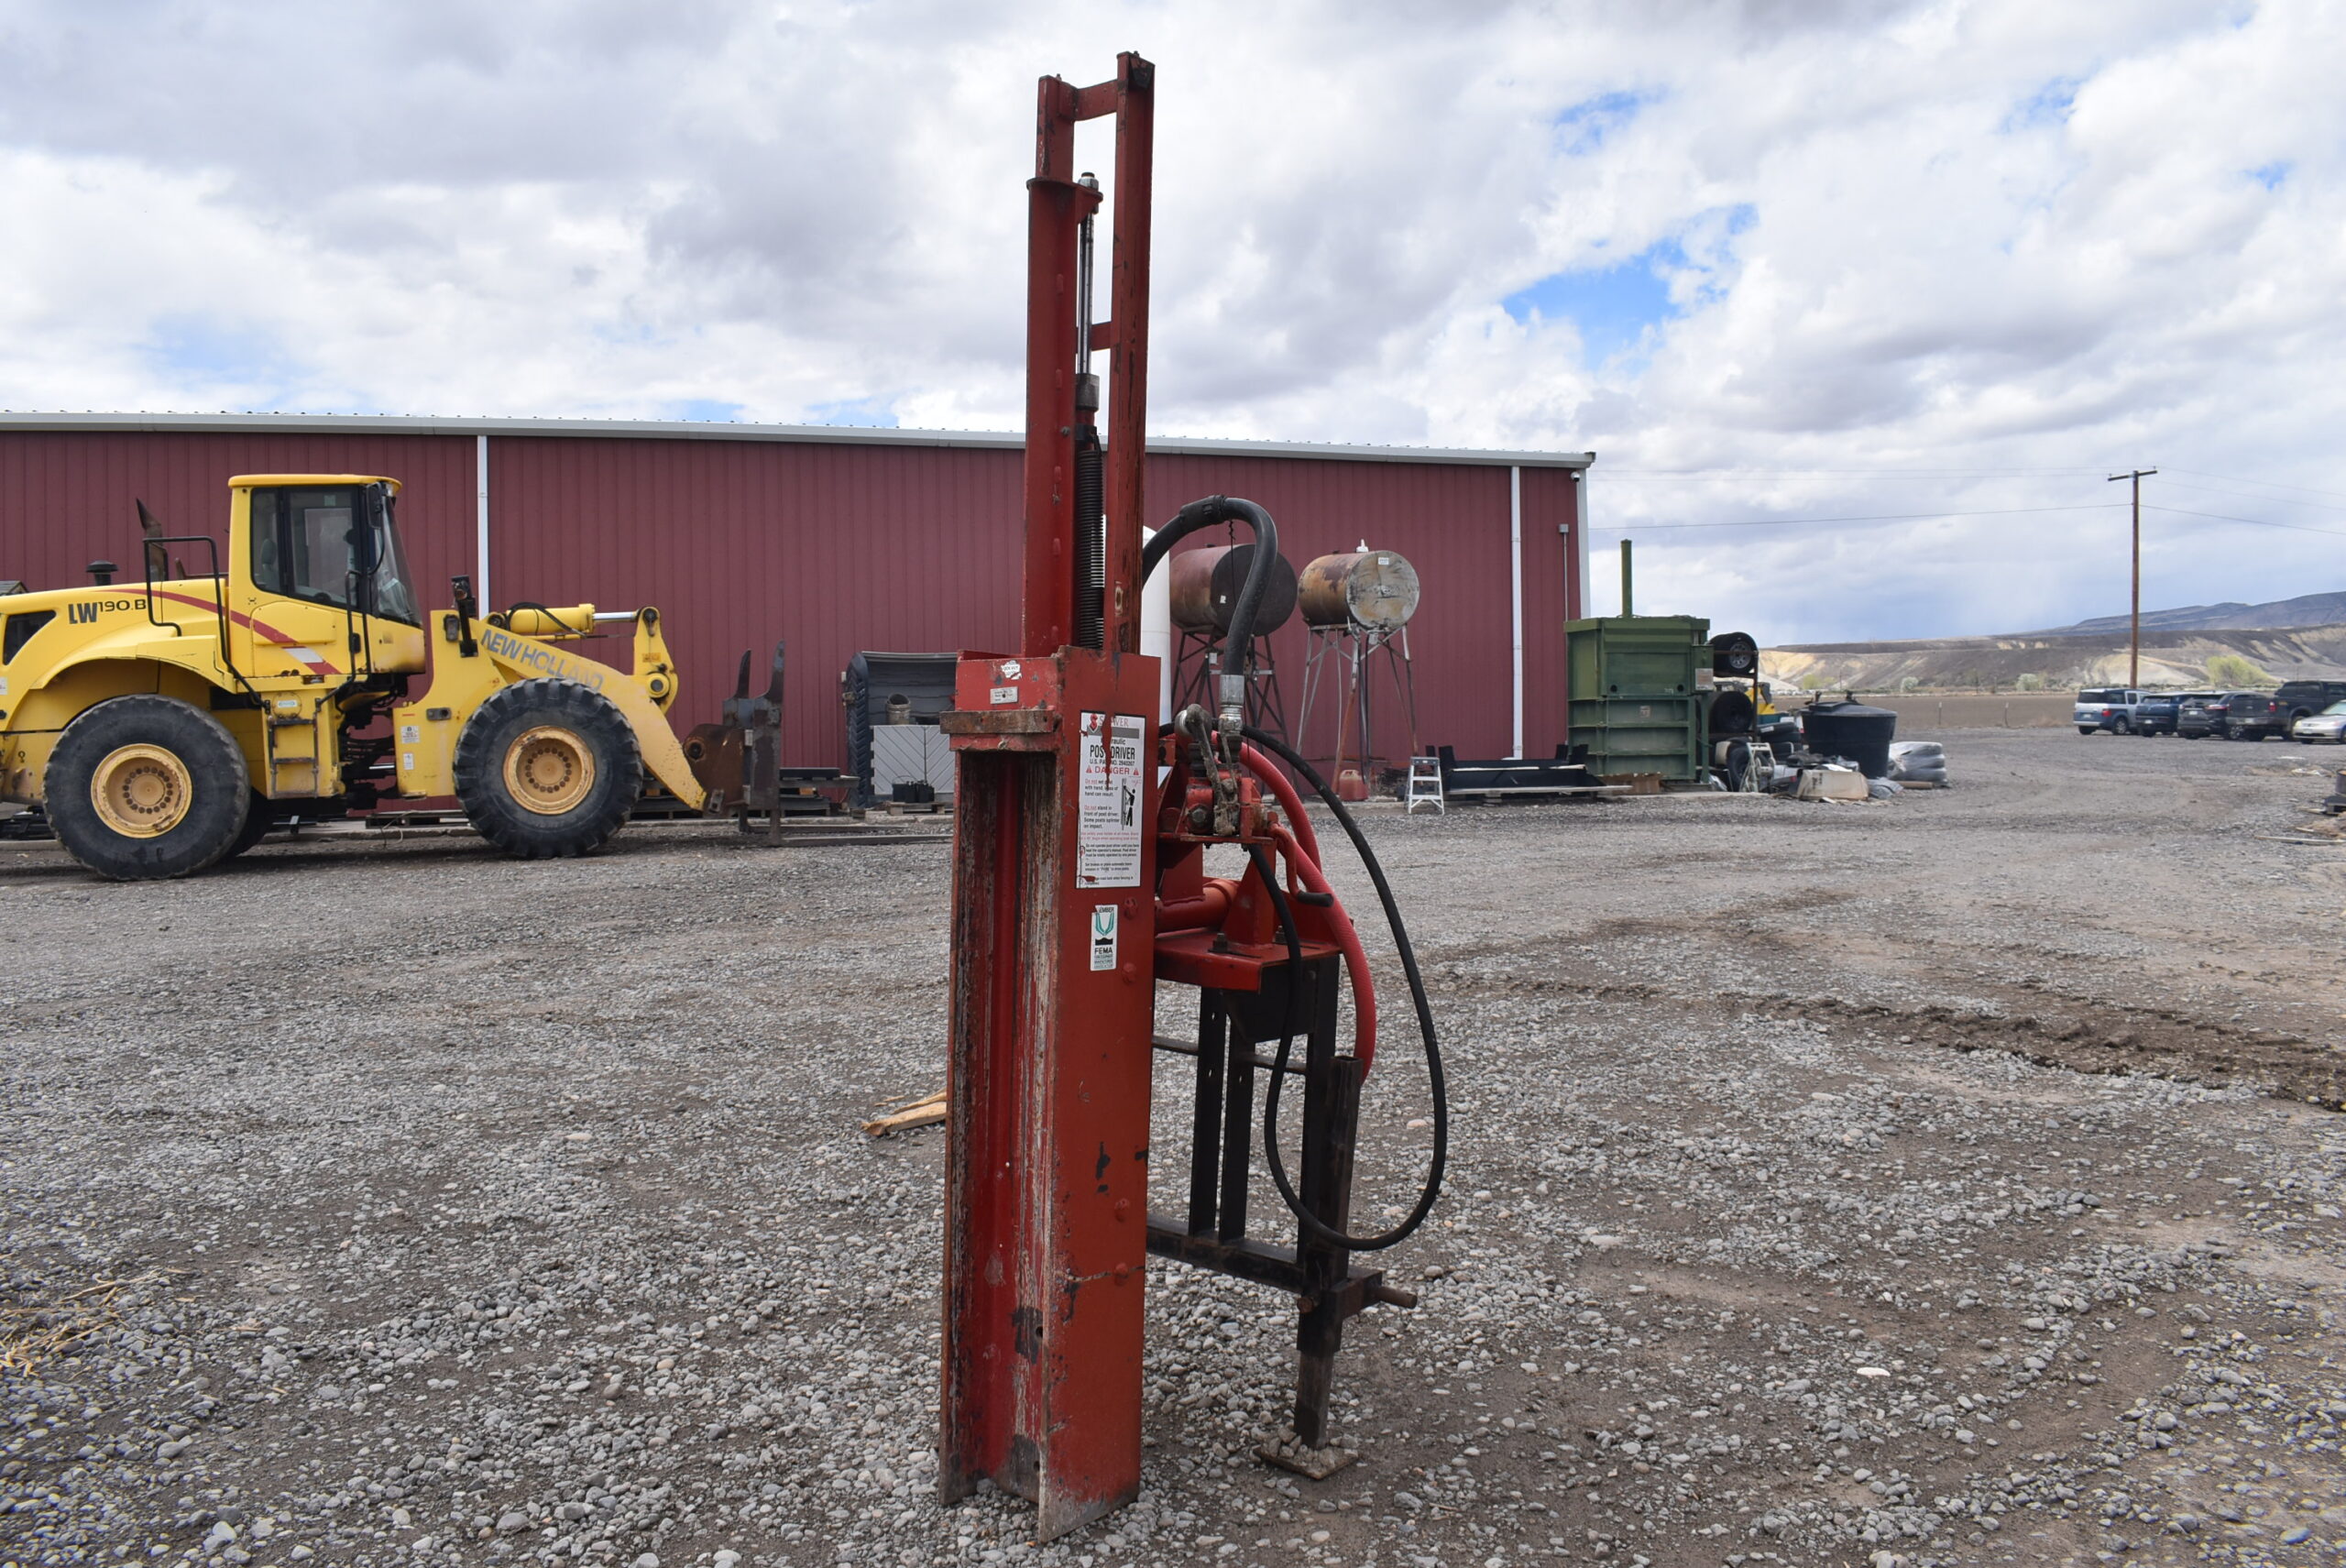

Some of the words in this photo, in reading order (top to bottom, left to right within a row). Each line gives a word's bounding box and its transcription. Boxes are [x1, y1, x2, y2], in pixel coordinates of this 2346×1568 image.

[481, 629, 522, 660] NEW
[1090, 744, 1105, 759] POS
[1111, 746, 1135, 761] DRIVER
